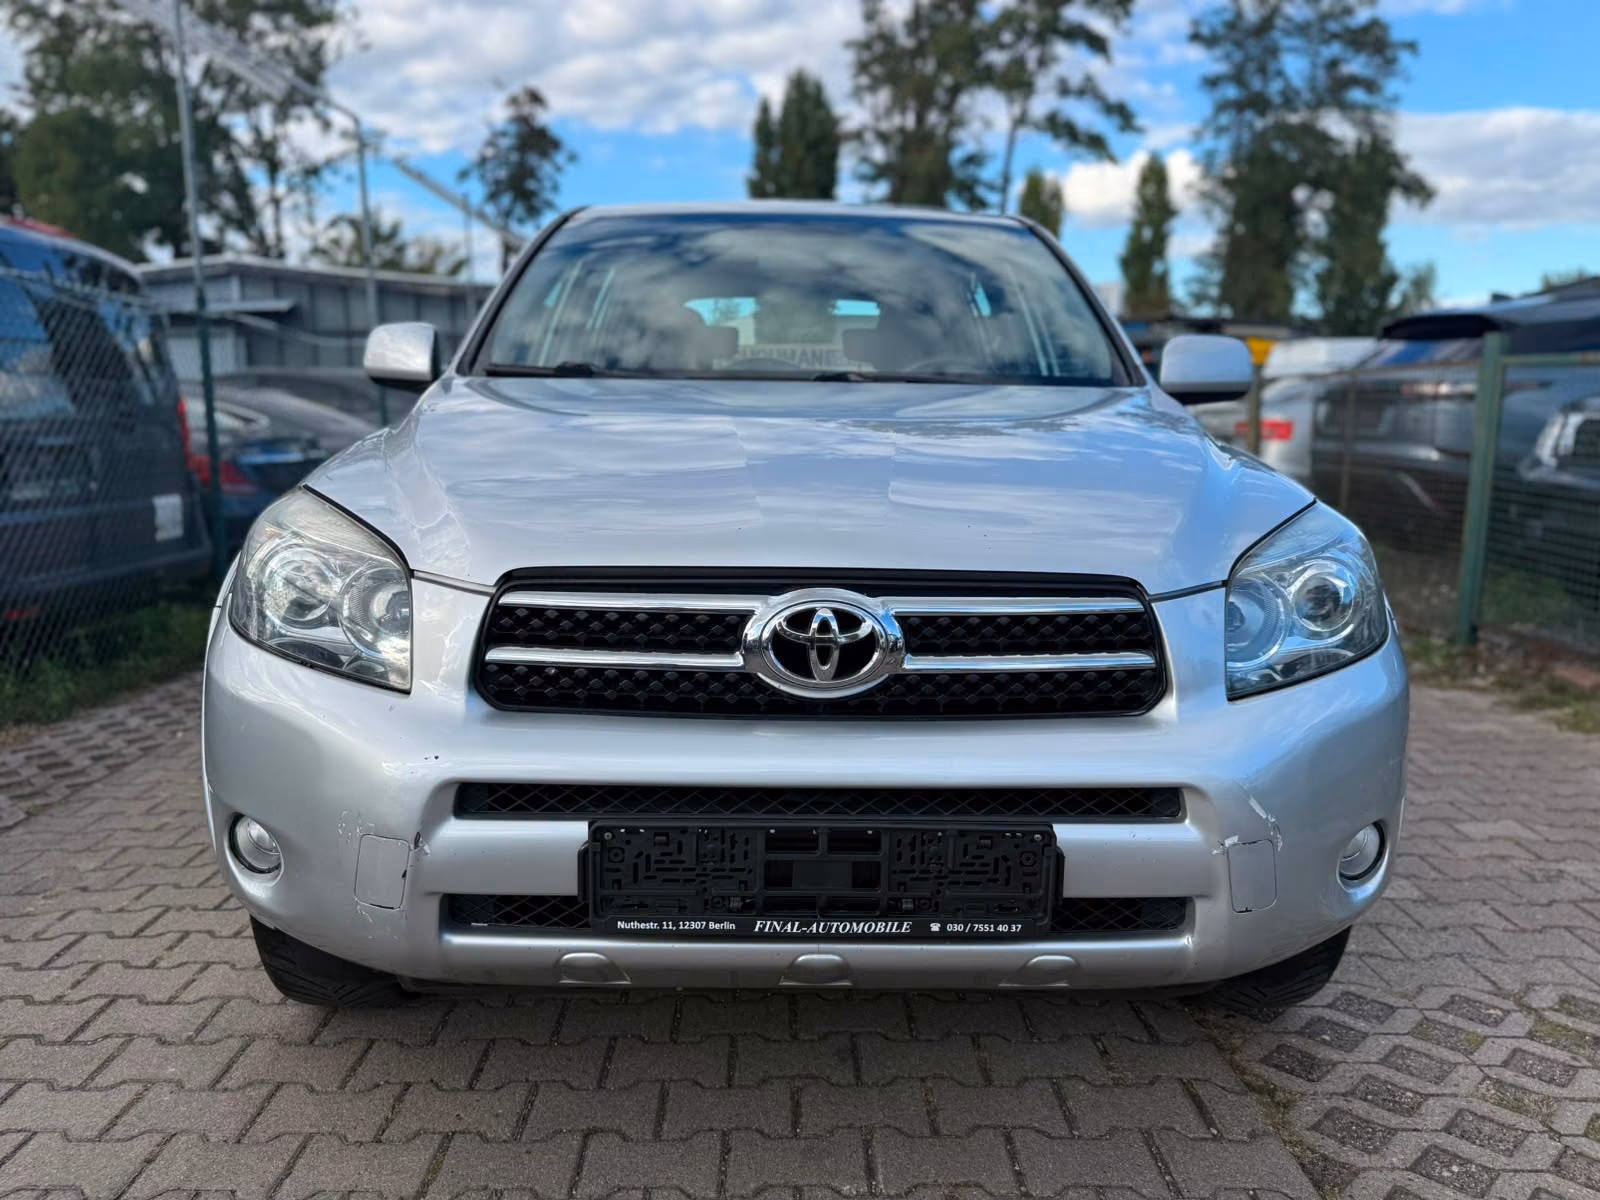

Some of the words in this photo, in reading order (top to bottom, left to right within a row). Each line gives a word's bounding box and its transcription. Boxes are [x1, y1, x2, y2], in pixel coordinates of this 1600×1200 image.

[617, 919, 661, 931] Nuthestr.
[661, 920, 678, 932] 11,
[677, 920, 707, 931] 12307
[707, 920, 737, 931] Berlin
[752, 919, 914, 935] FINAL-AUTOMOBILE
[946, 922, 965, 933] 030
[965, 922, 972, 933] /
[972, 922, 996, 933] 7551
[995, 923, 1010, 933] 40
[1009, 923, 1023, 934] 37
